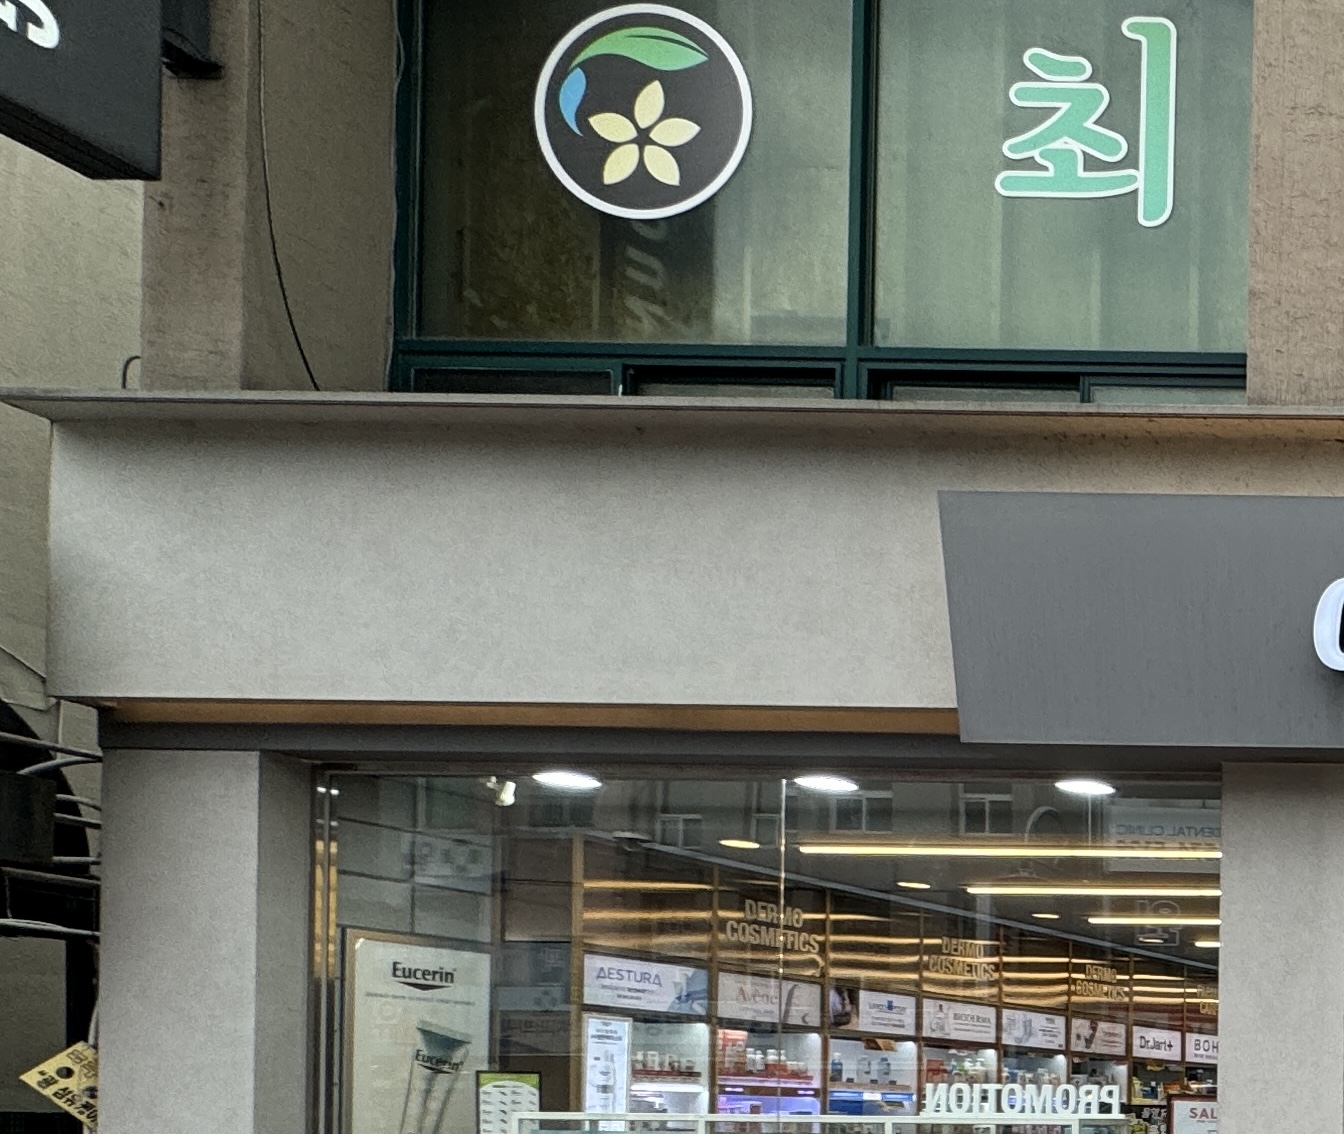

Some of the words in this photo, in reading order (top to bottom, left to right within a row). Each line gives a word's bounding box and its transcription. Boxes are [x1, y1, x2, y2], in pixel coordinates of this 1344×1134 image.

[391, 961, 456, 984] Eucerin
[596, 966, 662, 987] AESTURA
[927, 956, 996, 982] COSMETICS
[1189, 1107, 1218, 1119] SAL
